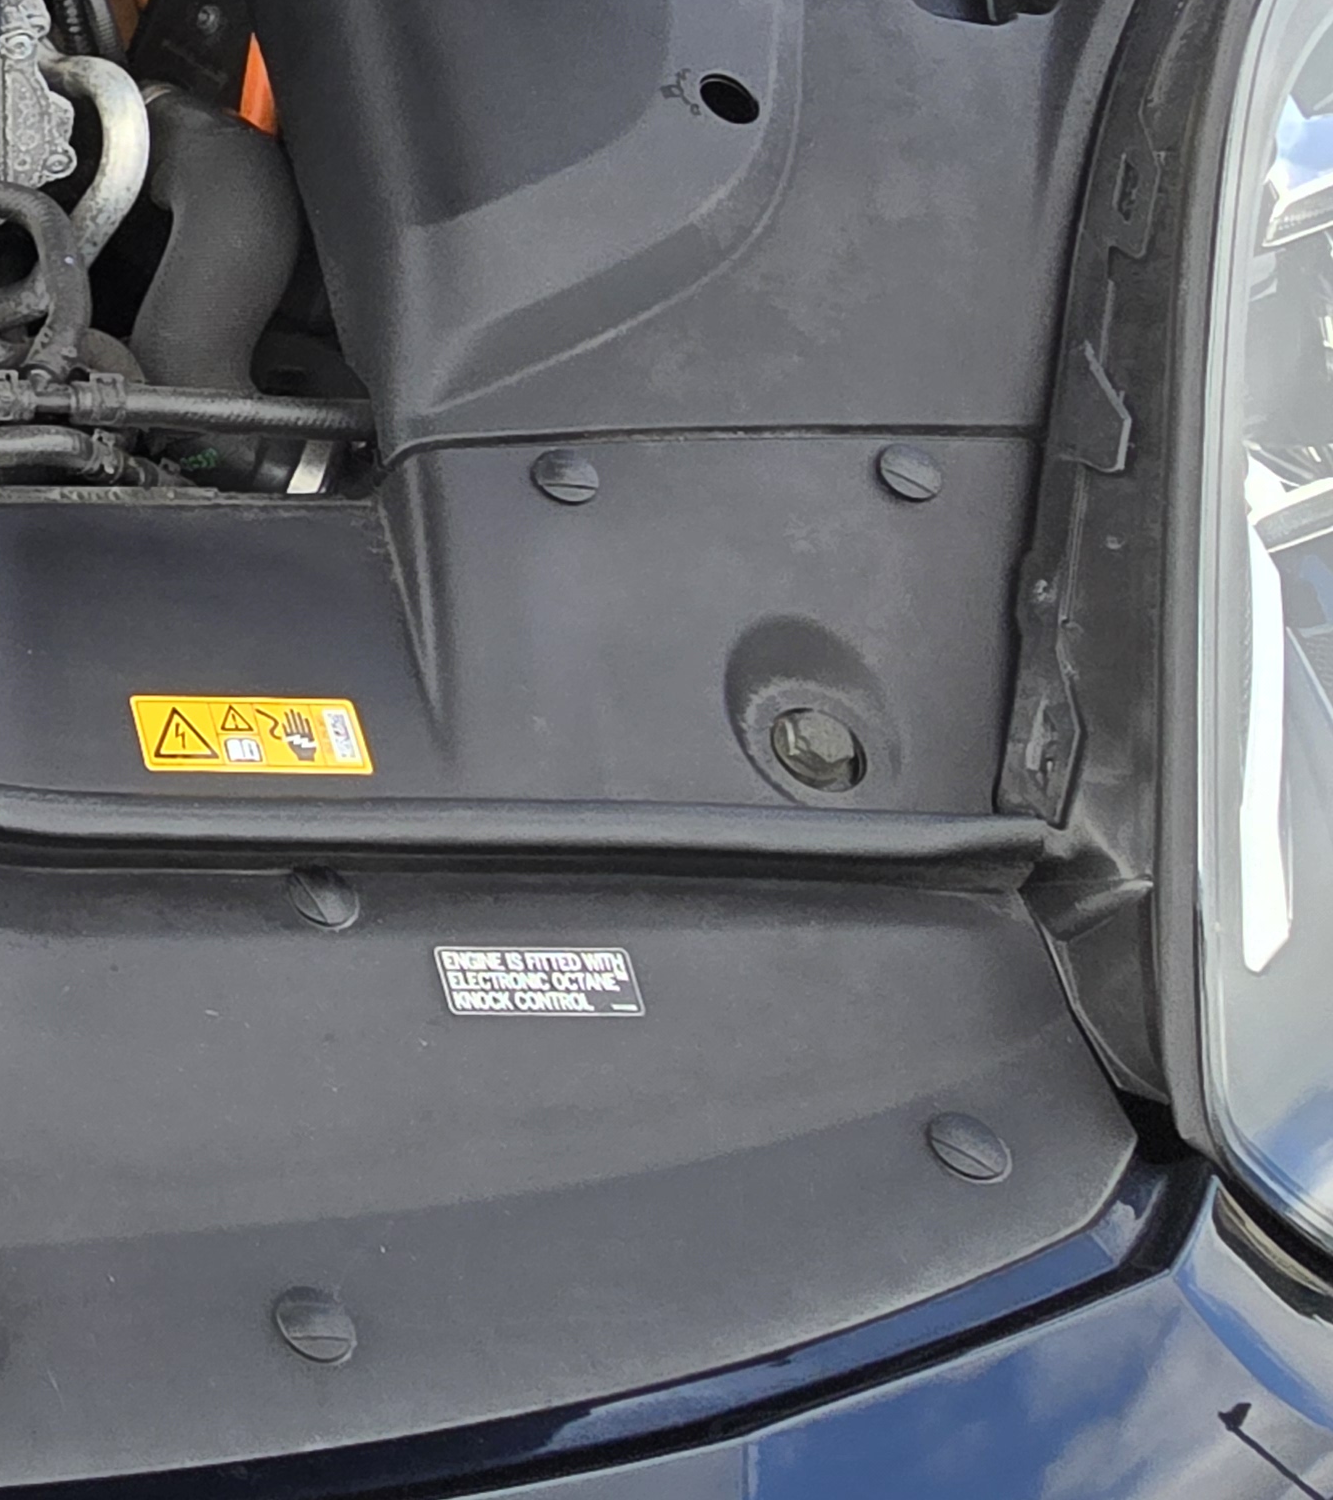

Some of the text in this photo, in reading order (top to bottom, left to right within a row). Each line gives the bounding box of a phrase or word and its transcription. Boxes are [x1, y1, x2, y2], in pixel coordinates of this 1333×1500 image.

[441, 951, 505, 970] ENGINE
[505, 952, 523, 970] IS
[525, 952, 582, 972] FITTED
[446, 972, 620, 992] ELECTRONIC OCTANE
[452, 991, 595, 1012] KNOCK CONTROL
